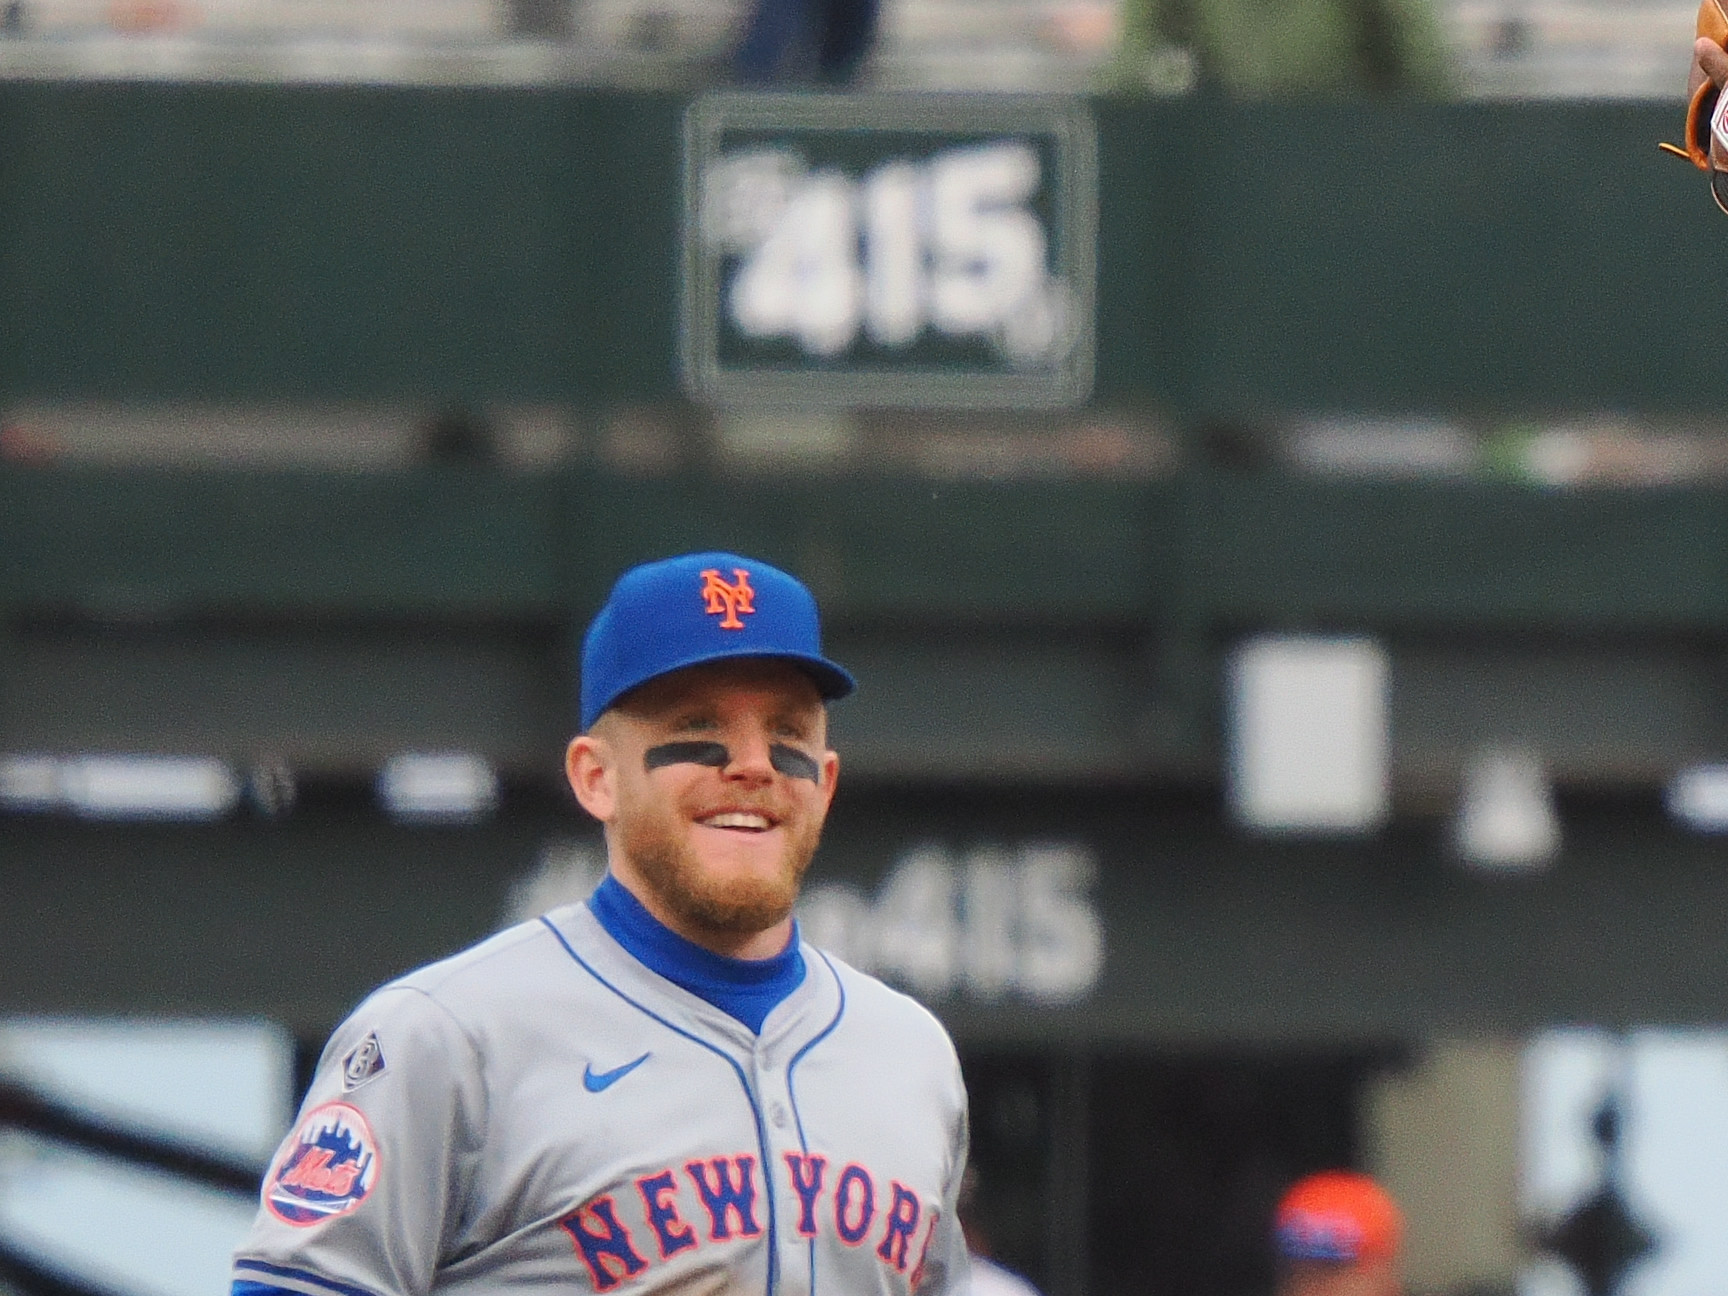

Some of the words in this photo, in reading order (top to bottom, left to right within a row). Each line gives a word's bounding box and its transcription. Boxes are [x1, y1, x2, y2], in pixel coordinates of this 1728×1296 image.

[732, 140, 1053, 356] 415
[559, 1154, 768, 1293] NEW
[784, 1150, 941, 1295] YOR
